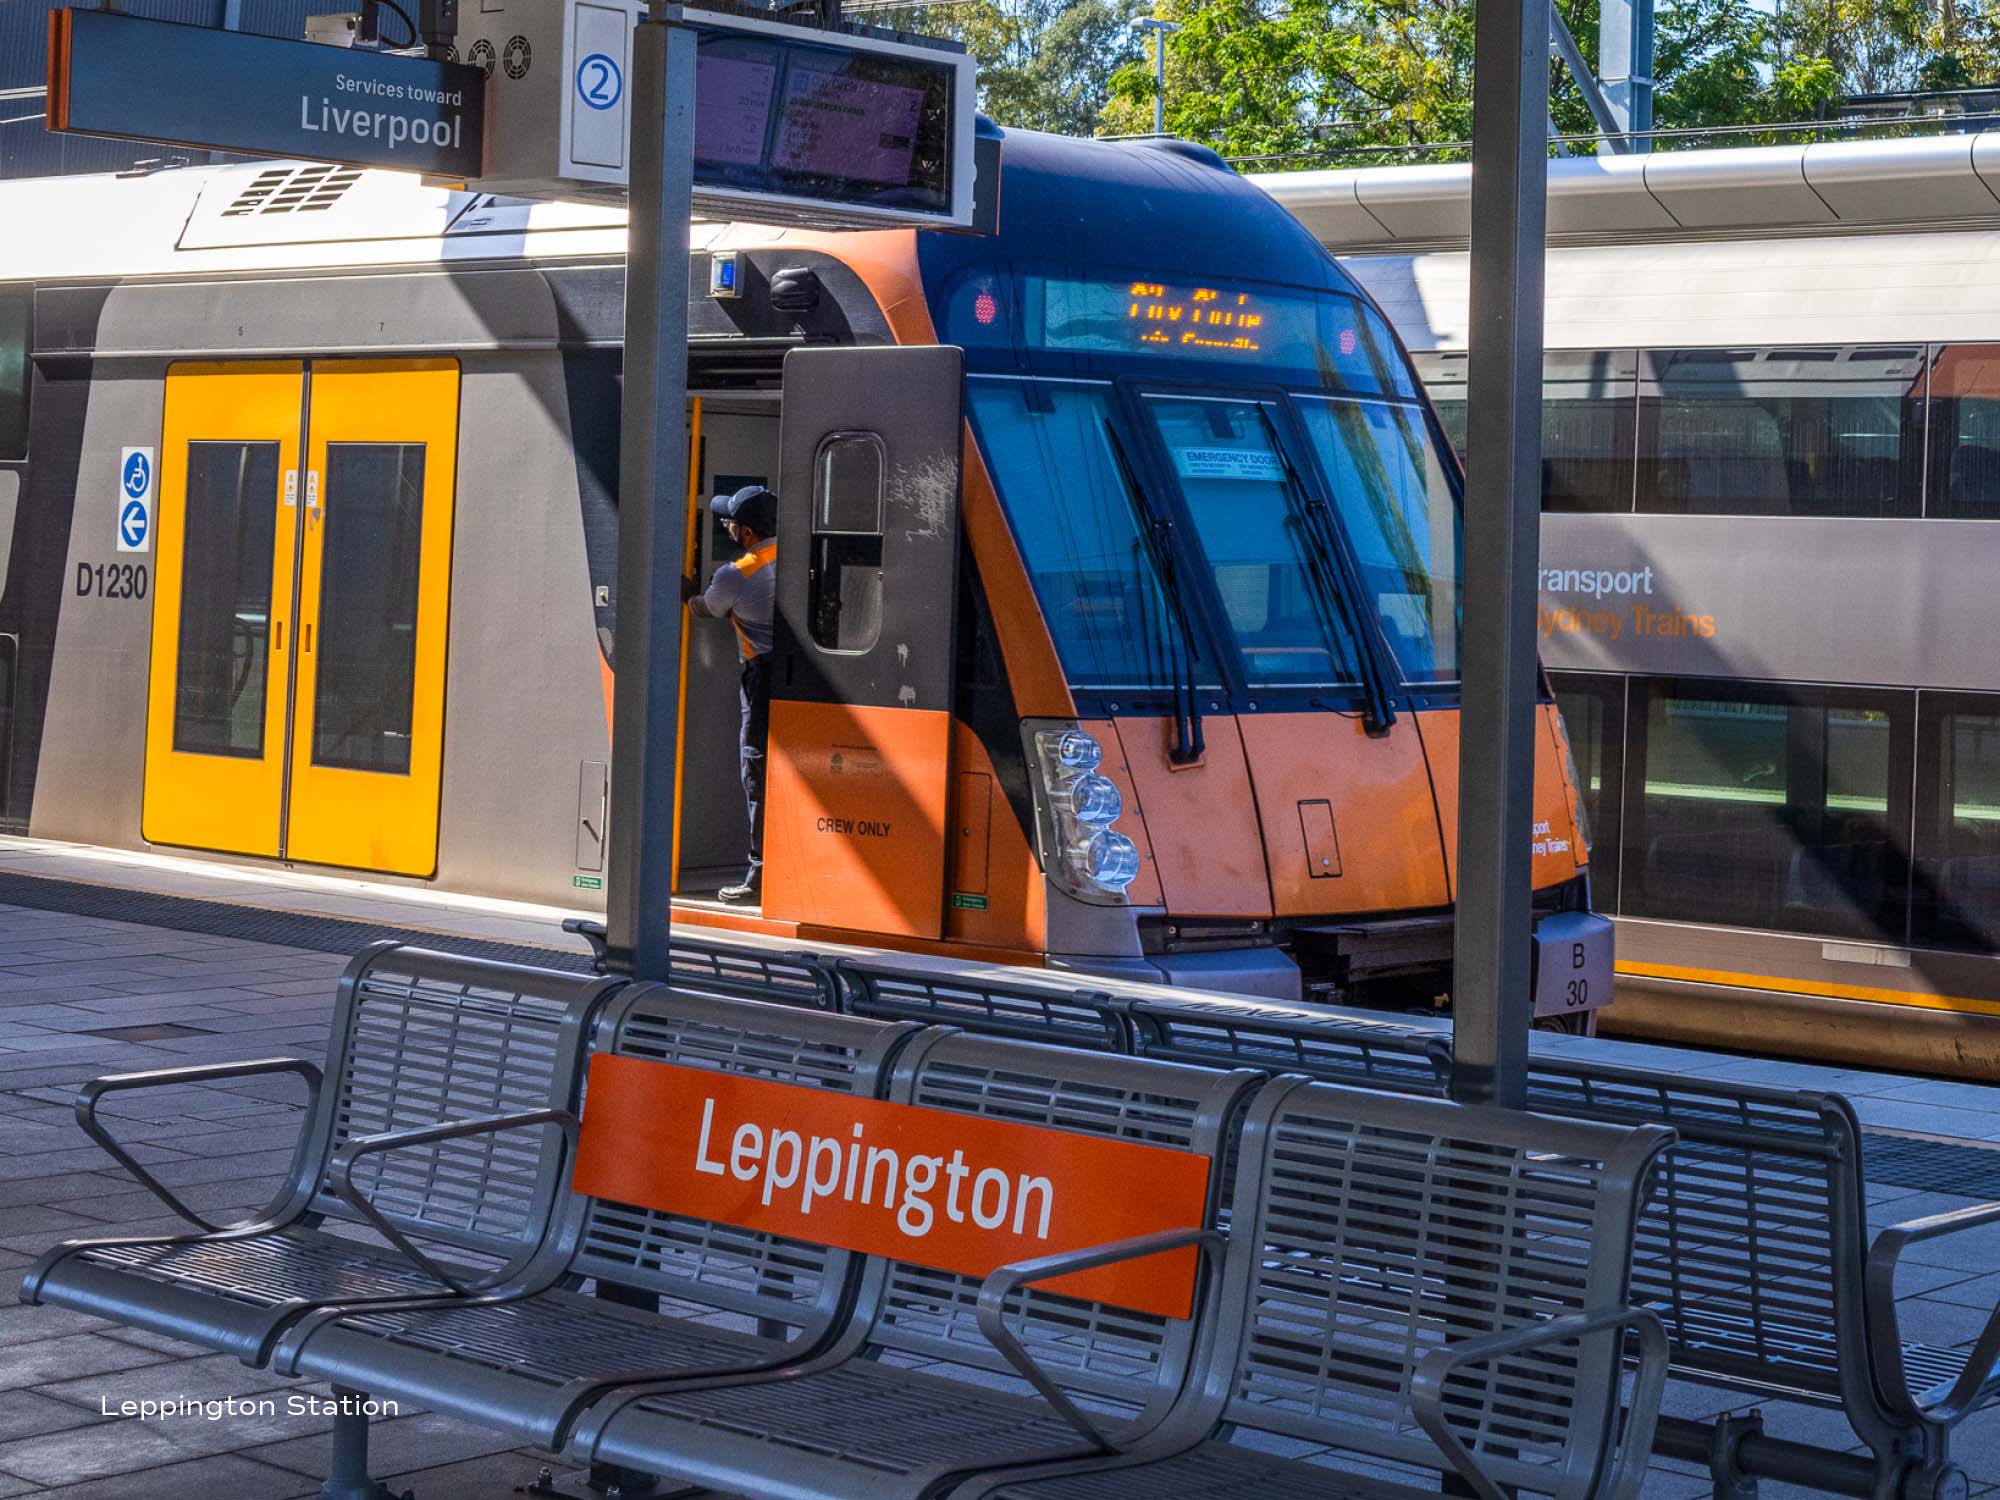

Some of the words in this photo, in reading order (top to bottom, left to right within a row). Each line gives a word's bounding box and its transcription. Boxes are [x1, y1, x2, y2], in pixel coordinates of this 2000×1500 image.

[335, 73, 404, 101] Services
[406, 84, 462, 106] toward
[588, 63, 609, 101] 2
[301, 95, 461, 149] Liverpool
[1185, 451, 1248, 464] EMERGENCY
[76, 562, 148, 600] D1230
[1538, 565, 1654, 599] ransport
[1631, 603, 1717, 640] Trains
[816, 816, 855, 834] CREW
[857, 820, 891, 838] ONLY
[1572, 942, 1585, 969] B
[1566, 978, 1588, 1007] 30
[694, 1097, 1055, 1240] Leppington
